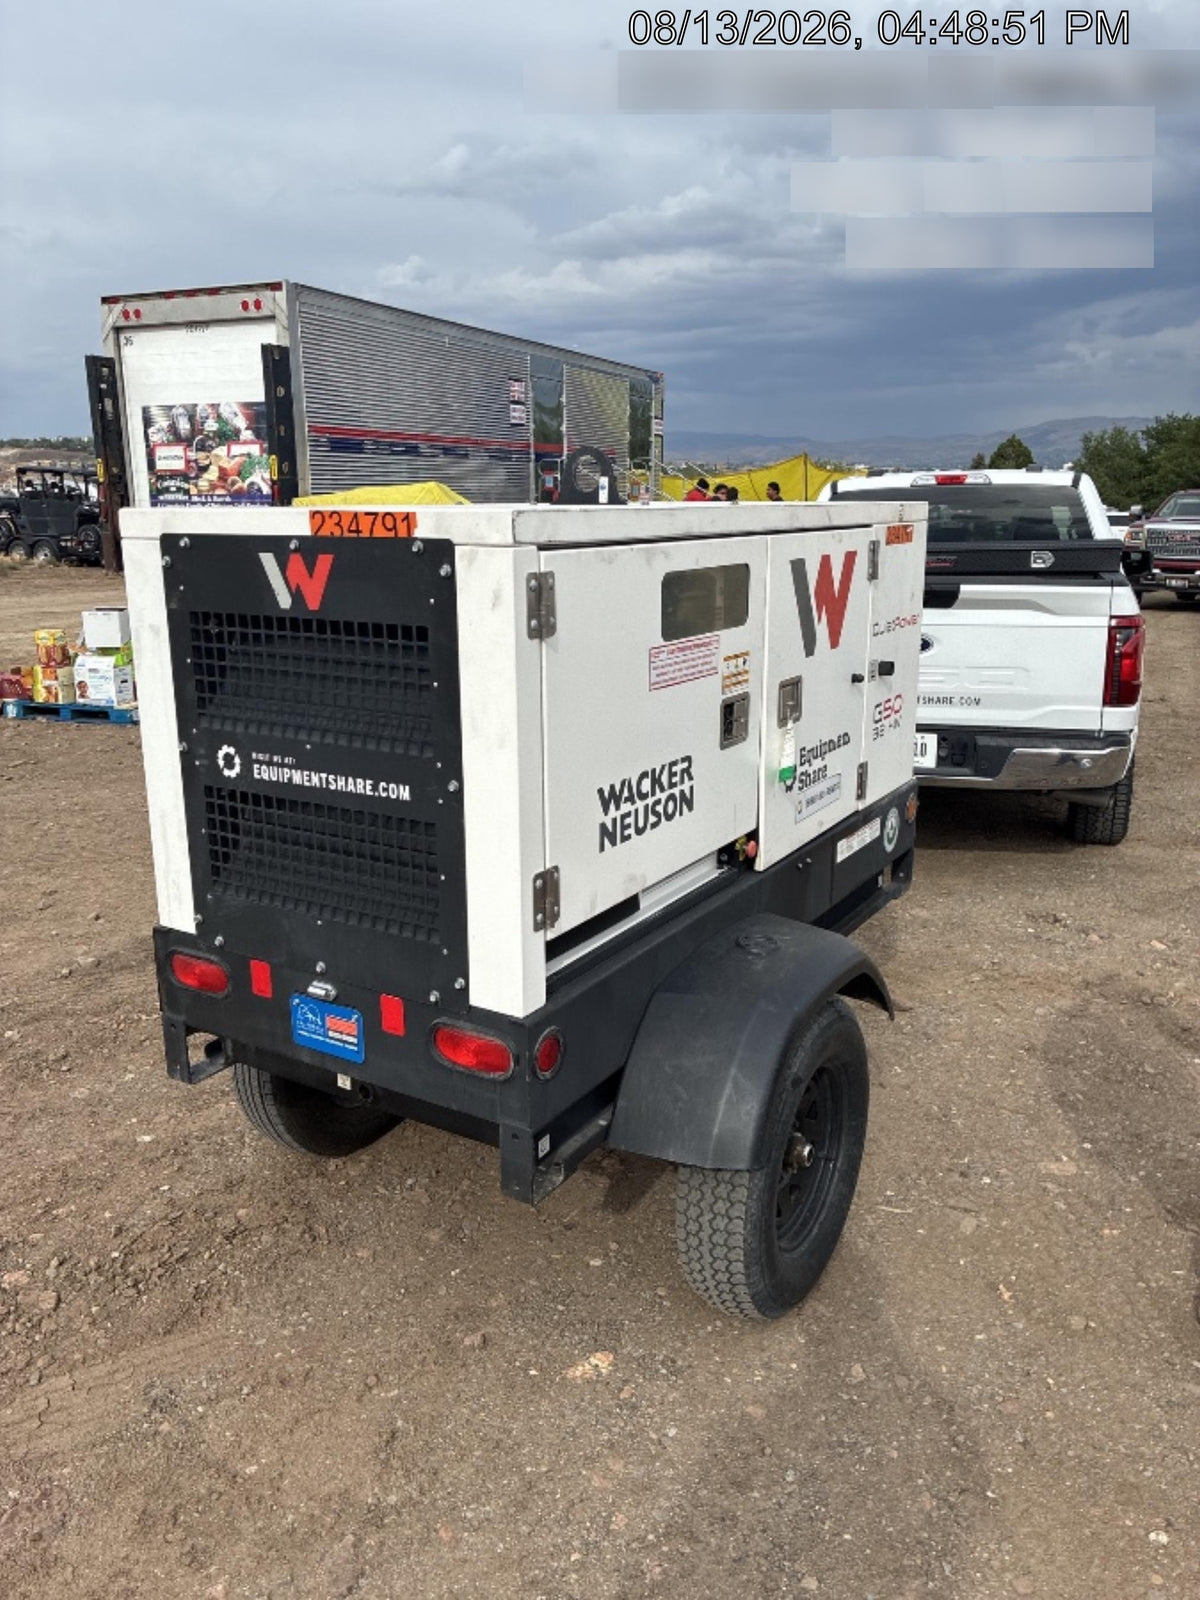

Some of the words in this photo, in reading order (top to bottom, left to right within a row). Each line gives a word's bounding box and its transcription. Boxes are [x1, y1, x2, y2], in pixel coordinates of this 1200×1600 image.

[311, 510, 415, 538] 234791
[253, 763, 411, 801] EQUIPMENTSHARE.COM
[597, 755, 694, 817] WACKER
[798, 763, 828, 791] Share
[598, 785, 694, 853] NEUSON
